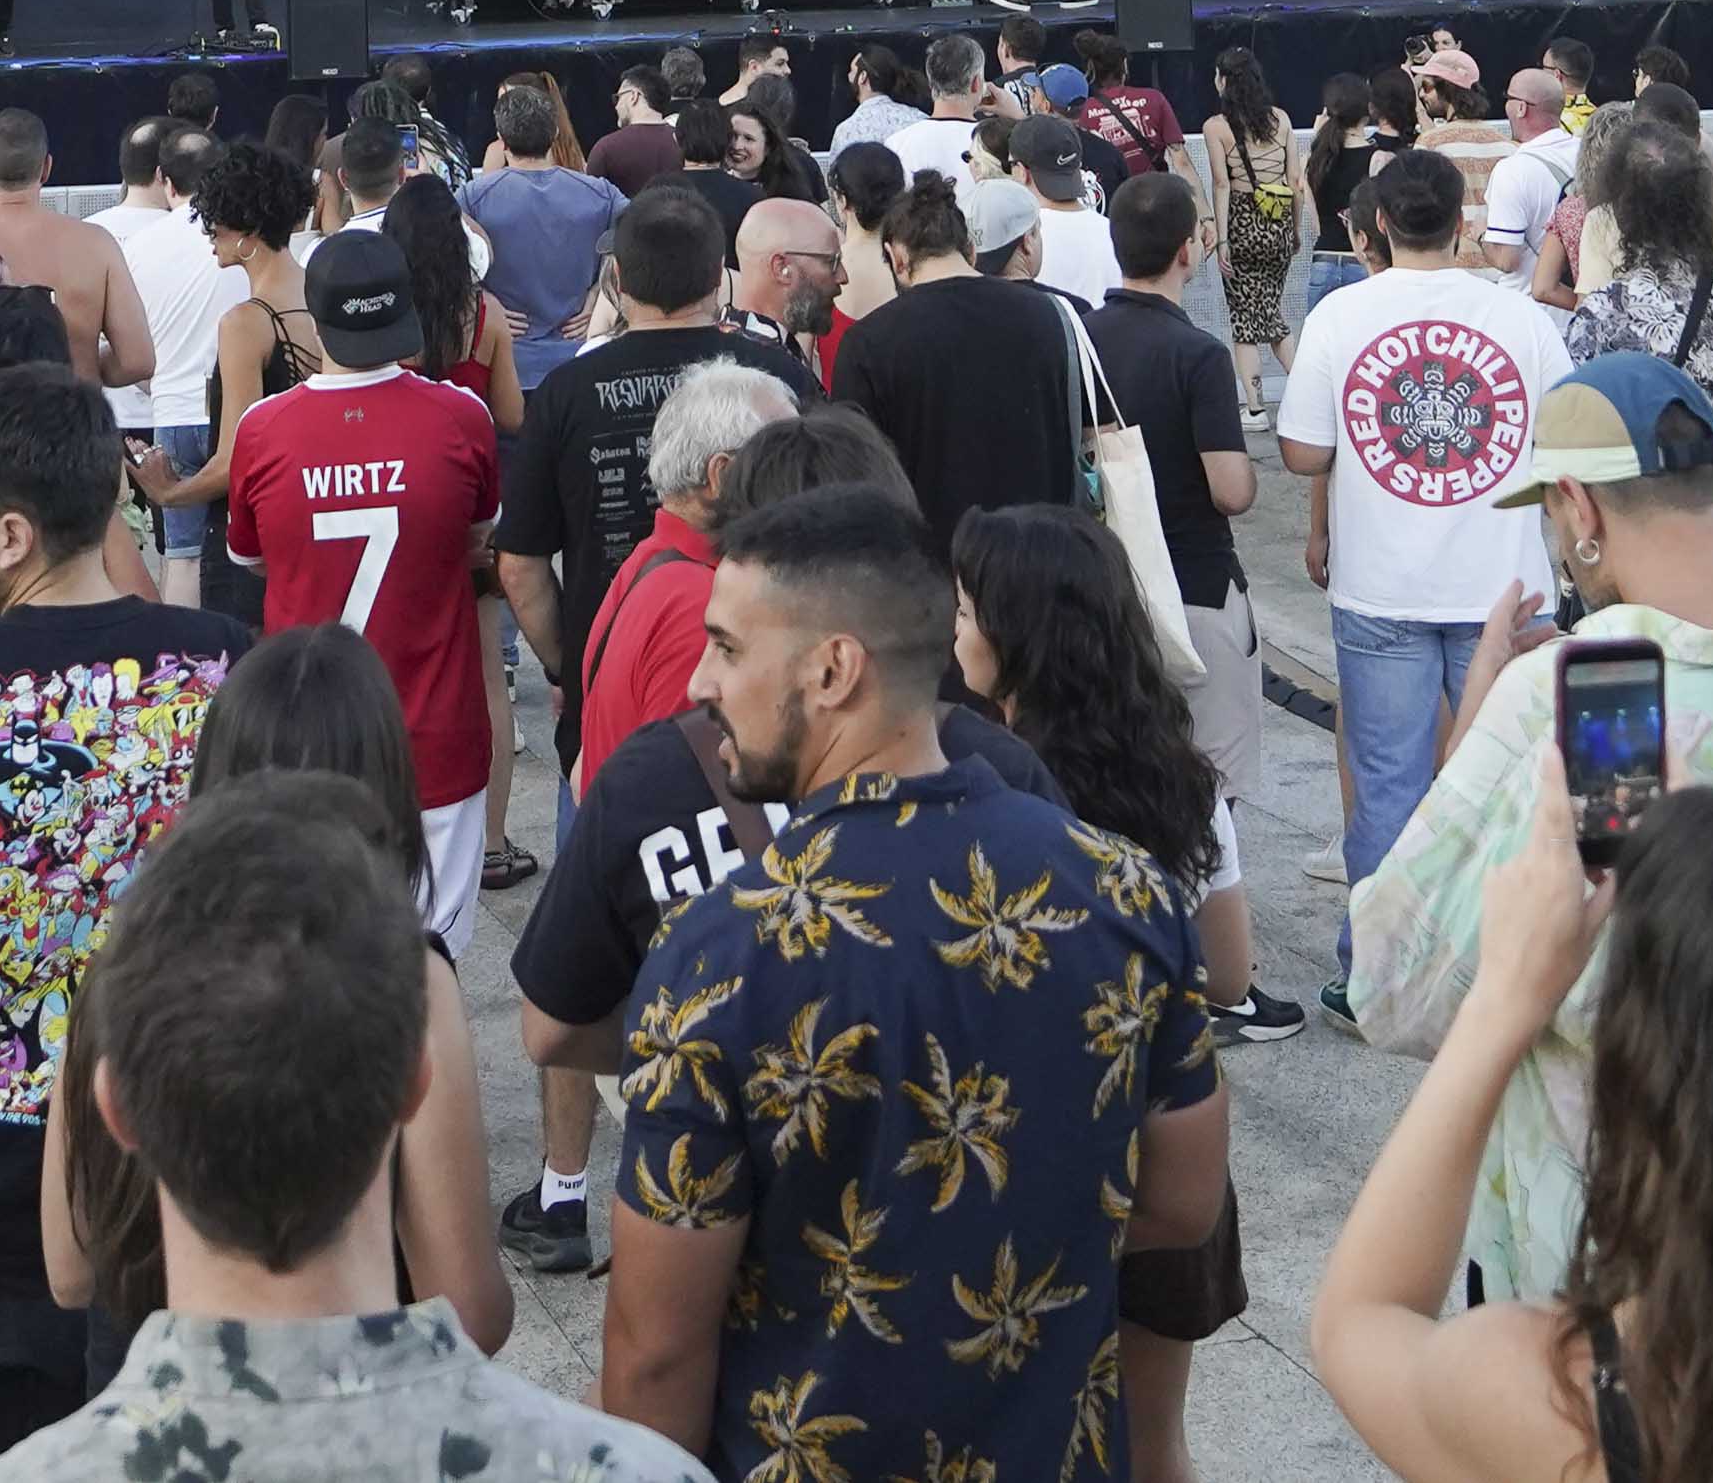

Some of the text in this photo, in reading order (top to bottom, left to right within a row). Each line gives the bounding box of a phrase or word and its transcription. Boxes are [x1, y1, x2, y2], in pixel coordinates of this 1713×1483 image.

[302, 460, 407, 499] WIRTZ
[1347, 325, 1525, 503] RED HOT CHILI PEPPERS
[312, 505, 400, 637] 7
